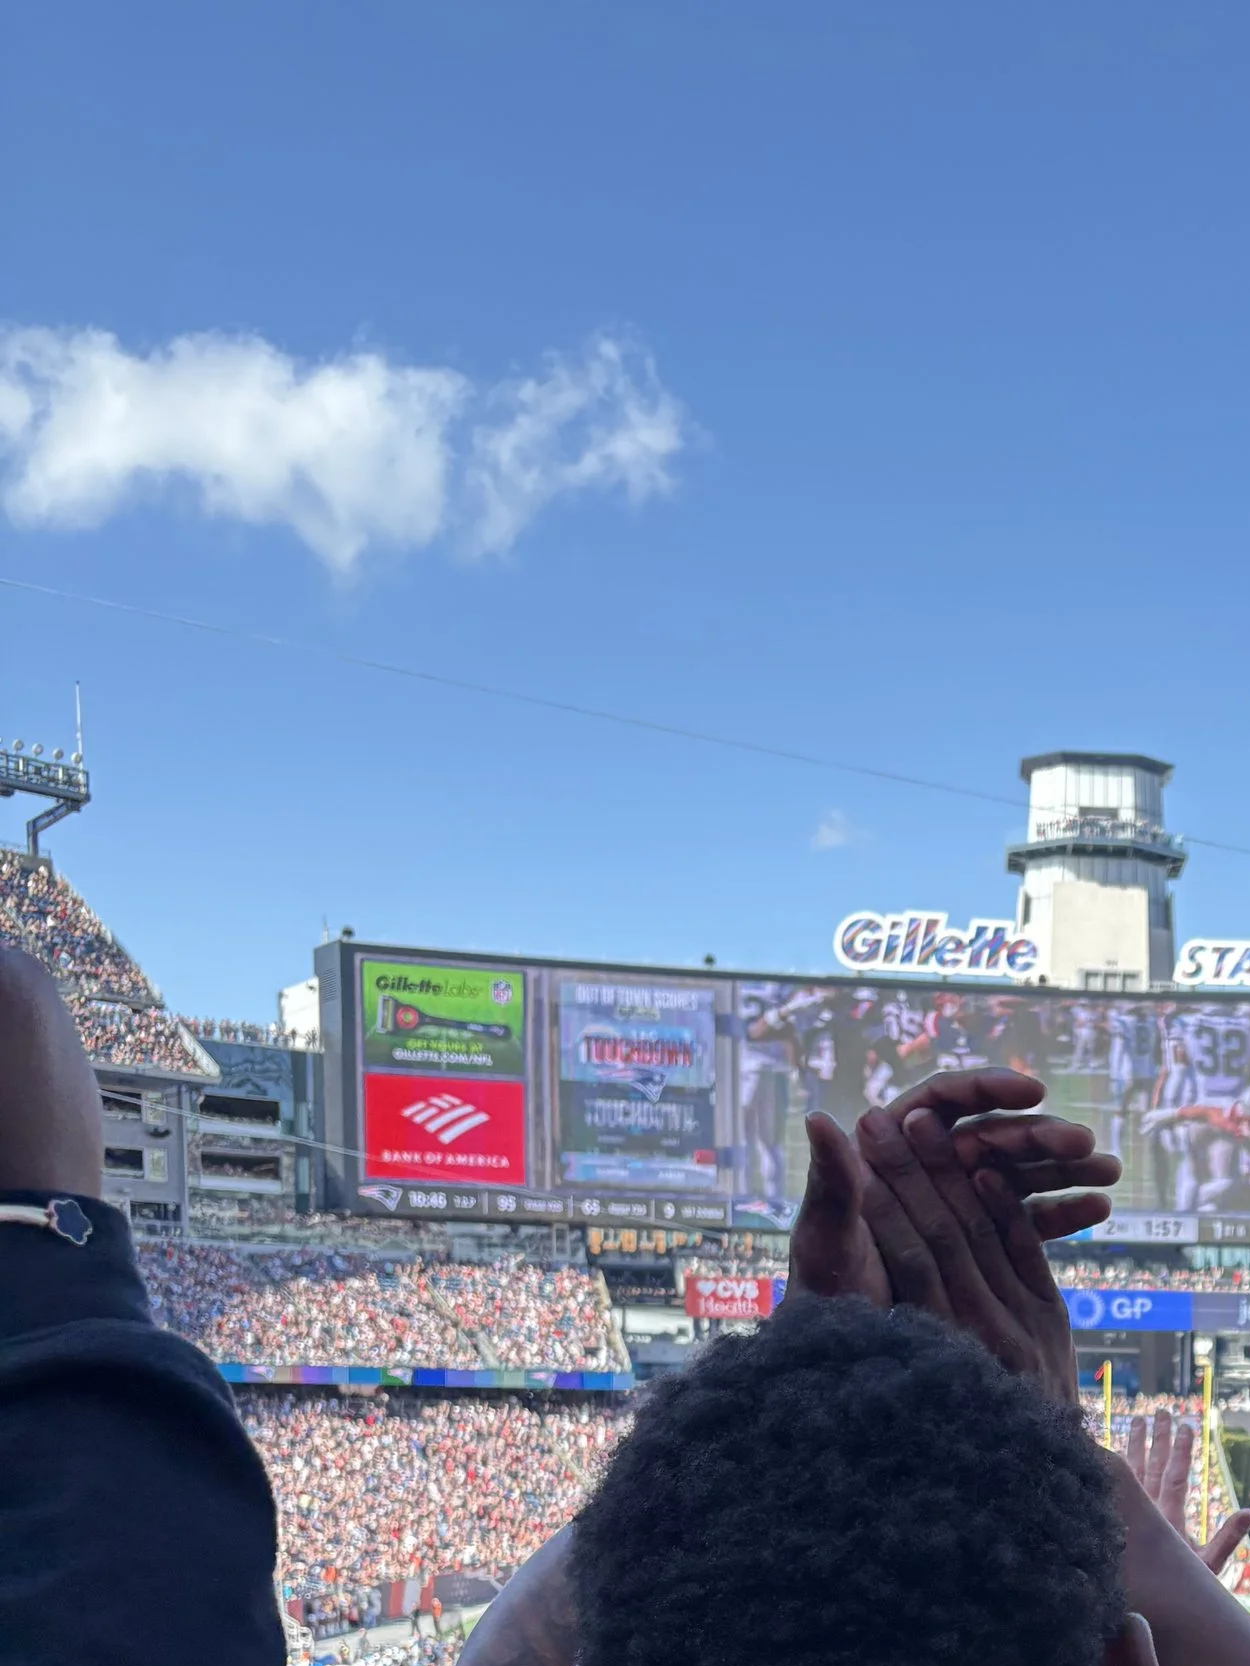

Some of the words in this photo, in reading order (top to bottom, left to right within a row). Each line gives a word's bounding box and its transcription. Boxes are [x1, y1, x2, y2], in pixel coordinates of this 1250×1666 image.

[842, 917, 1038, 972] Gillette
[382, 1150, 422, 1163] BANK
[424, 1152, 442, 1164] OF
[445, 1154, 510, 1168] AMERICA
[1144, 1220, 1183, 1237] 1:57
[716, 1280, 759, 1299] CVS
[701, 1297, 759, 1314] Health
[1111, 1298, 1152, 1319] GP
